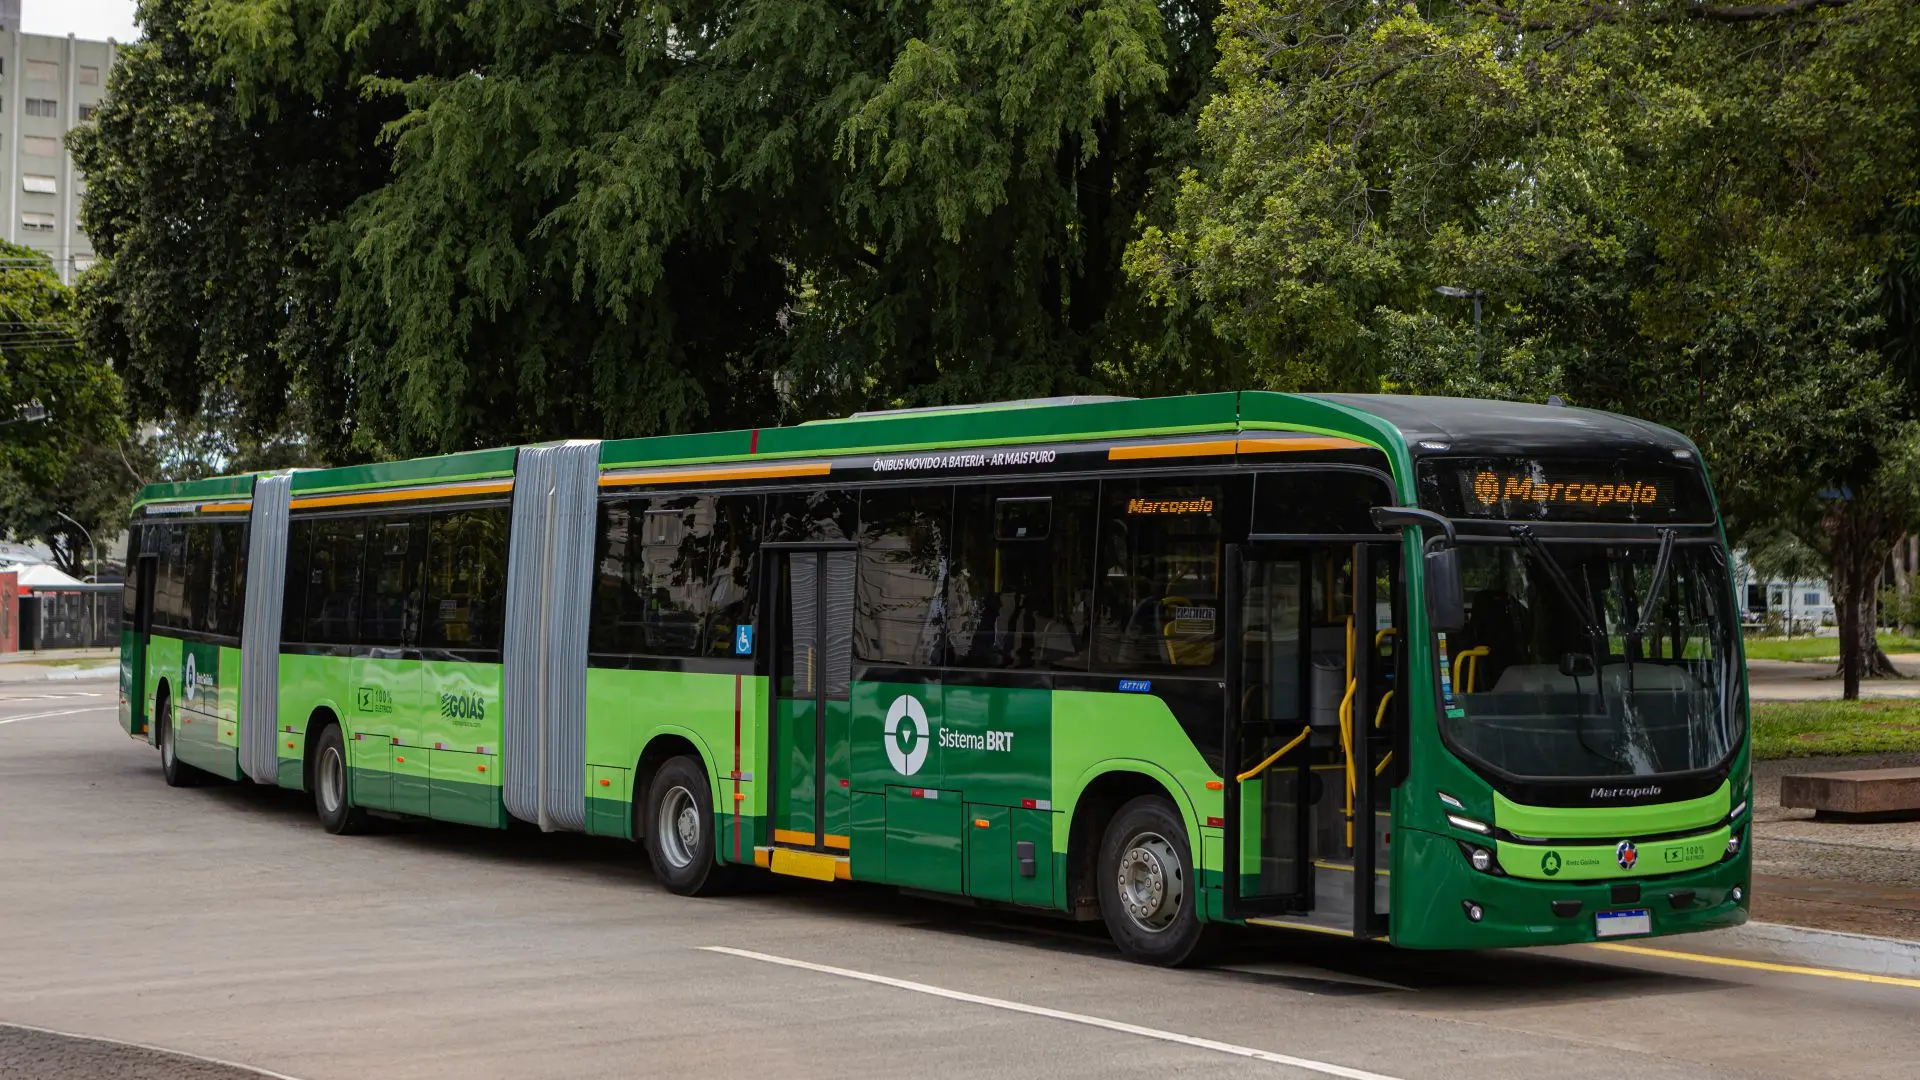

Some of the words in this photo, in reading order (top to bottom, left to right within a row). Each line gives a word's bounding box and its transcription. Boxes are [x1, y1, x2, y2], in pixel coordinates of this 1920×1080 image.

[872, 457, 904, 472] ÔNIBUS
[904, 456, 940, 471] MOVIDO
[940, 456, 948, 468] A
[949, 454, 985, 468] BATERIA
[990, 453, 1004, 466] AR
[1004, 451, 1029, 465] MAIS
[1029, 450, 1056, 464] PURO
[1503, 476, 1657, 507] Marcopolo
[1127, 497, 1213, 514] Marcopolo
[1122, 682, 1148, 690] ATTIVI
[375, 690, 392, 704] 100%
[450, 692, 485, 721] GOIÁS
[939, 728, 984, 750] Sistema
[986, 730, 1014, 752] BRT
[1590, 785, 1661, 799] Marcopolo
